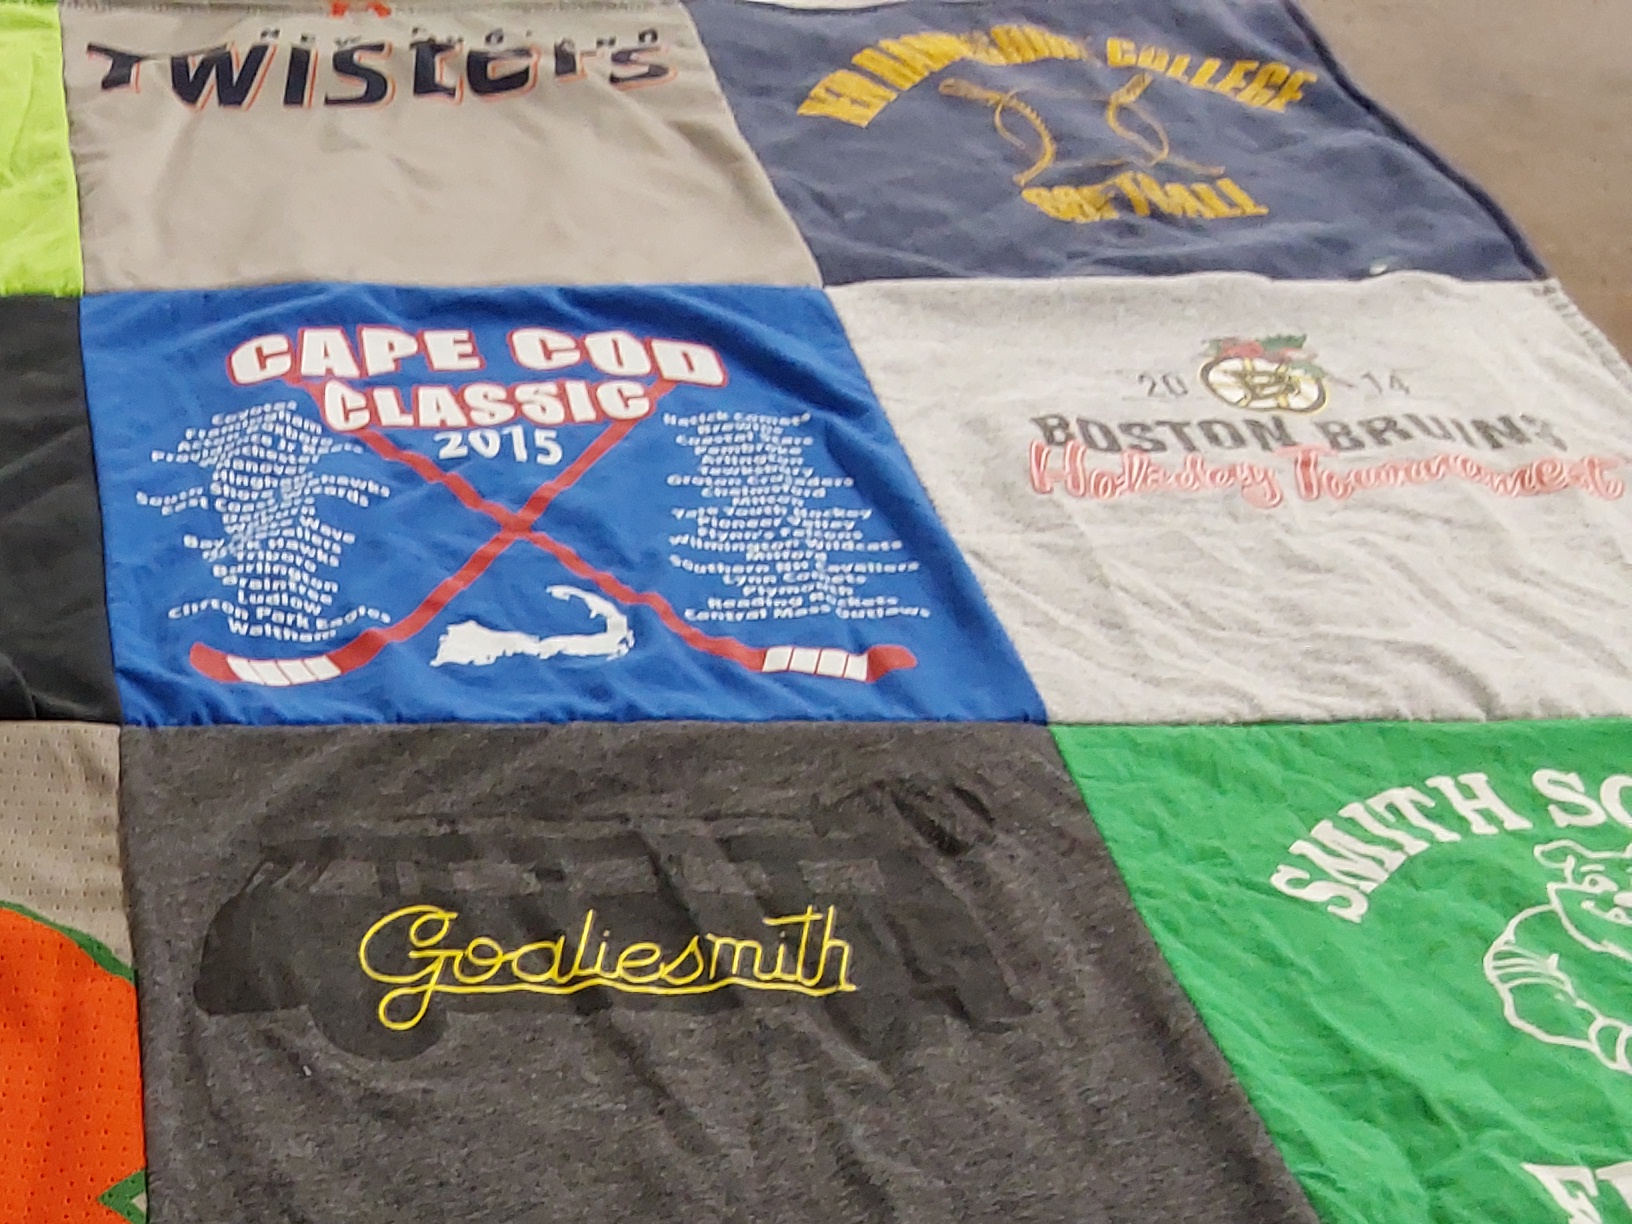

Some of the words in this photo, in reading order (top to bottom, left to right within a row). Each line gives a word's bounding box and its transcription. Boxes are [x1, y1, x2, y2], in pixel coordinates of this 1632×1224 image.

[227, 324, 485, 385] CAPE
[509, 328, 729, 387] COD
[323, 380, 653, 432] CLASSIC
[1137, 371, 1188, 399] 20
[432, 428, 563, 466] 2015
[1030, 412, 1299, 454] BOSTON
[1312, 411, 1571, 453] BRUINS
[1270, 772, 1533, 924] SMITH
[358, 905, 857, 1031] Goaliesmith
